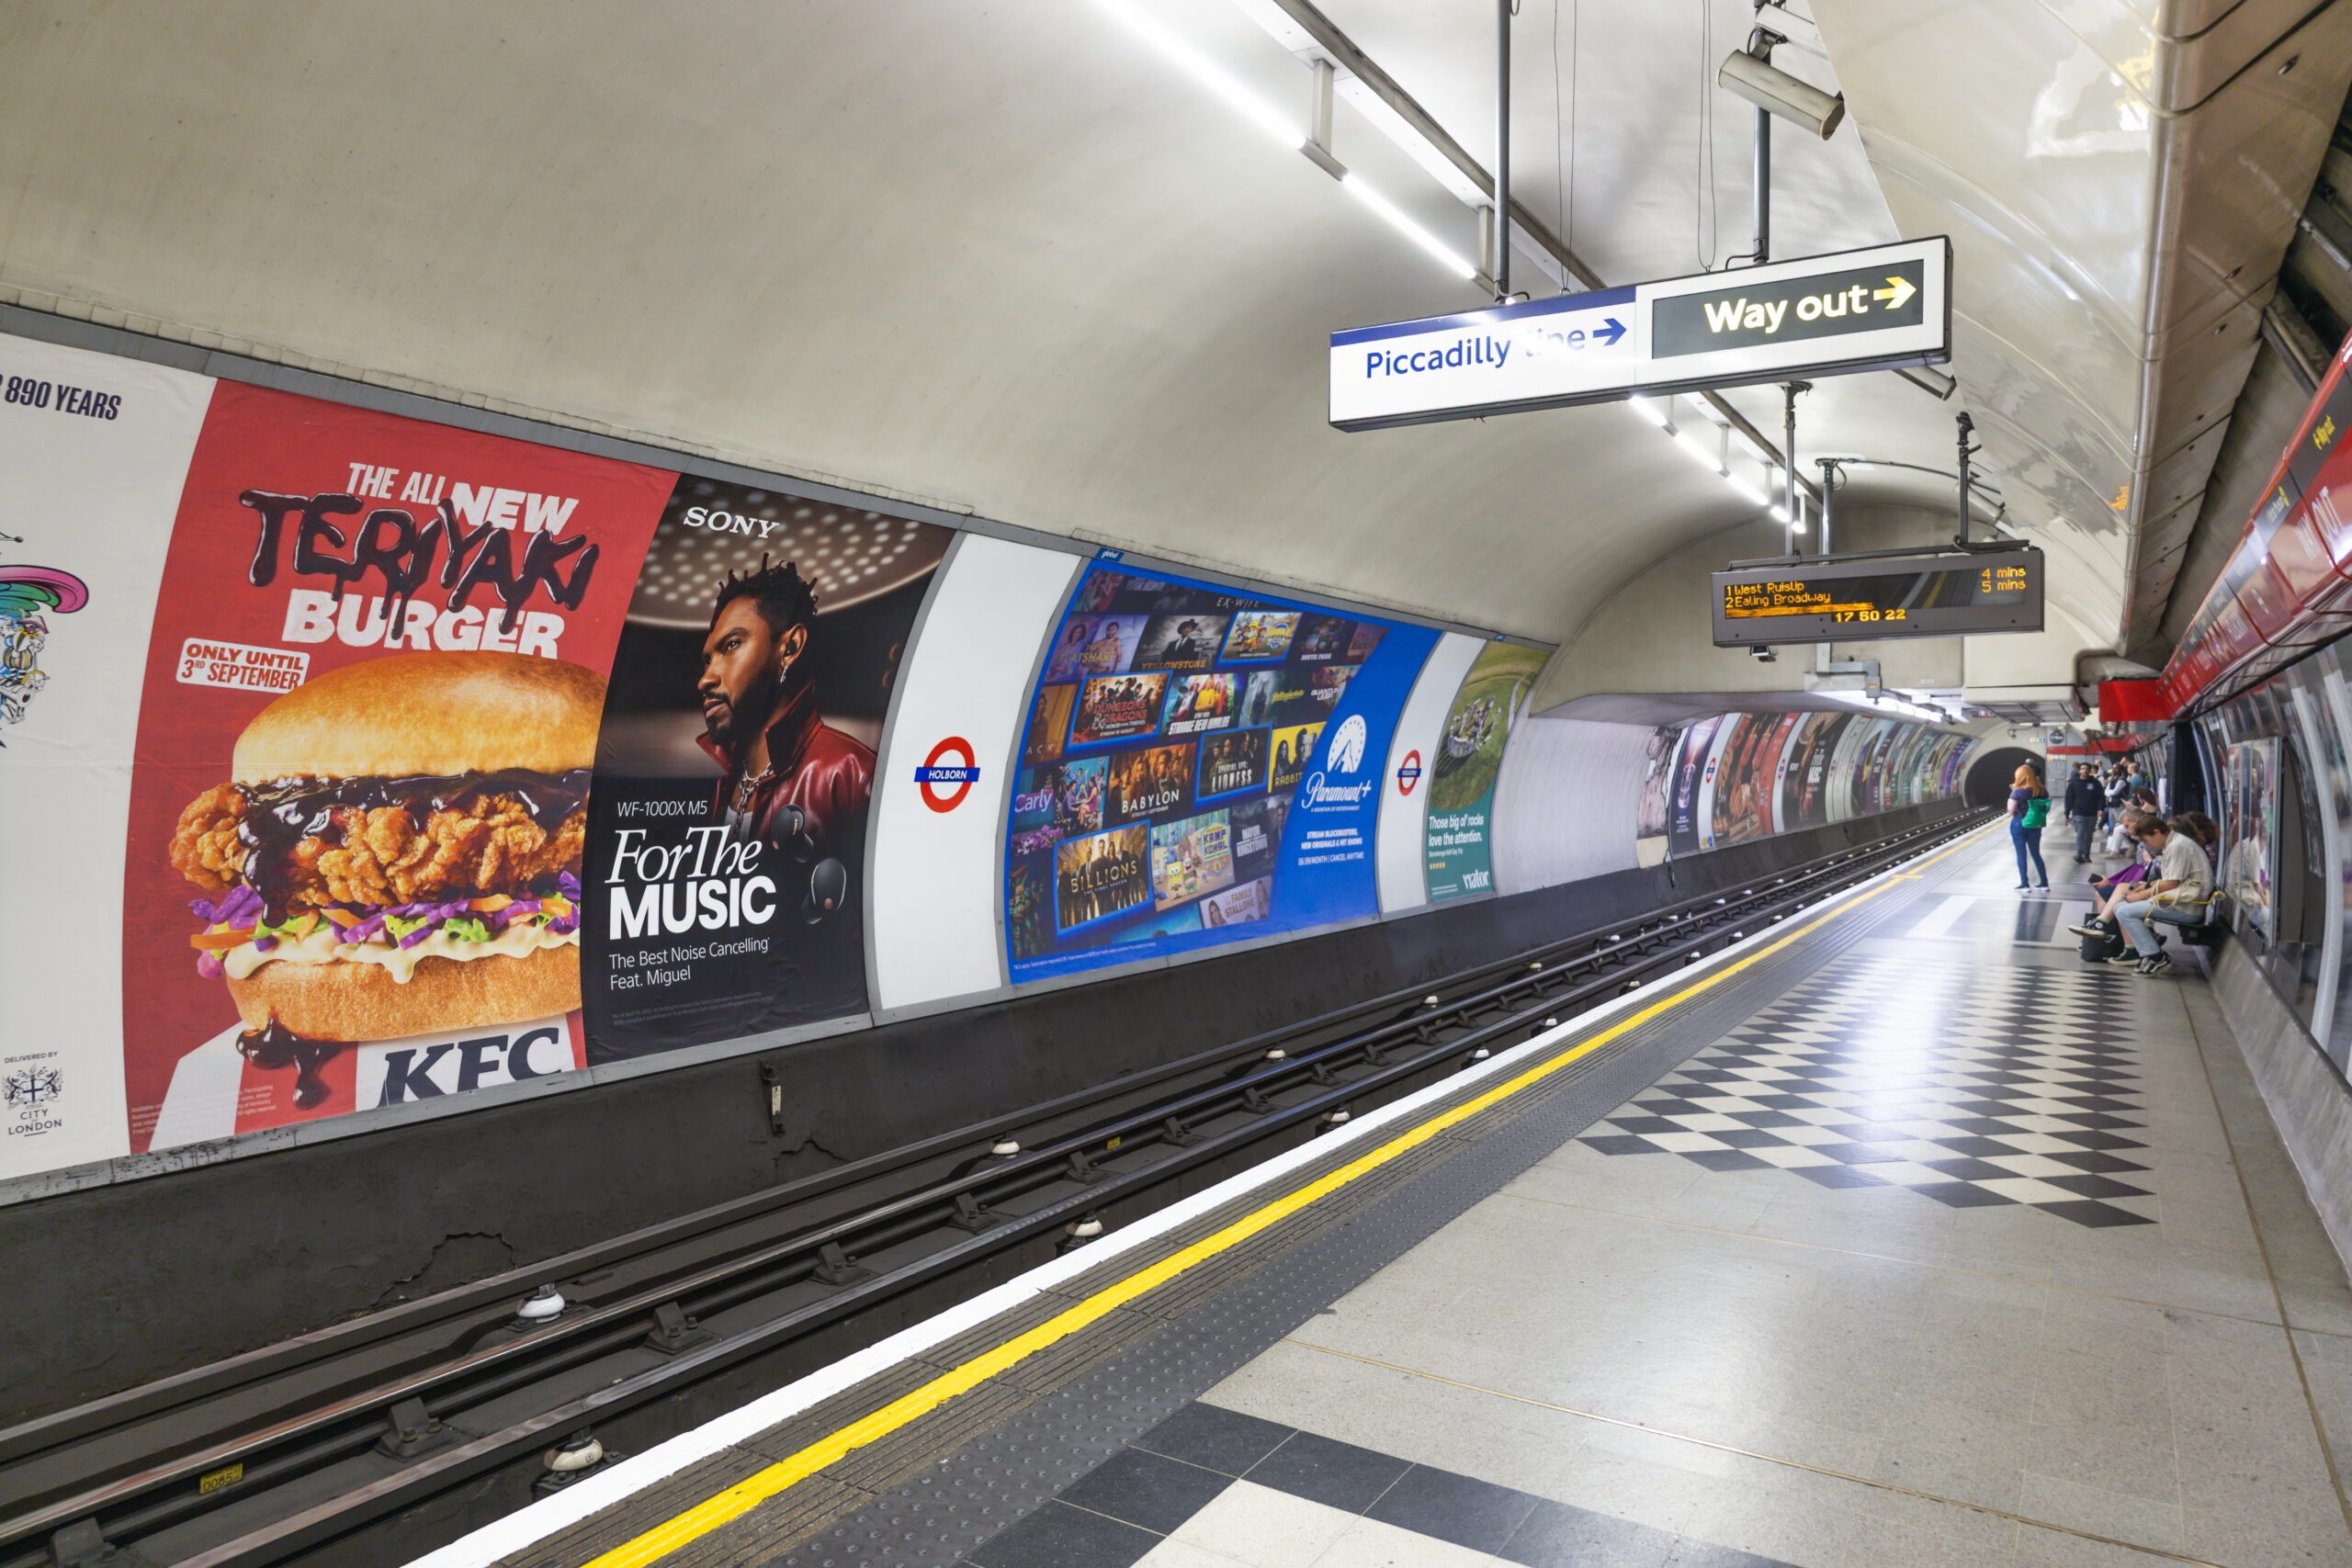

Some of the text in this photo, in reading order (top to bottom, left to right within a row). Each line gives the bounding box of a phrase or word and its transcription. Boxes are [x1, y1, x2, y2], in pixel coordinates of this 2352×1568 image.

[1704, 285, 1869, 334] Way out
[1367, 328, 1586, 378] Piccadilly ne
[5, 376, 52, 409] 890
[55, 384, 122, 421] YEARS
[346, 462, 580, 536] THE ALL NEW
[683, 506, 780, 540] SONY
[239, 489, 600, 625] TERIYAKI
[1725, 579, 2026, 608] 2 Ealing Broadway 5 mins
[1726, 566, 2026, 597] 1 West Ruislip 4 mins
[281, 588, 565, 660] BURGER
[1836, 612, 1854, 624] 17
[1884, 609, 1906, 620] 22
[187, 644, 304, 671] ONLY UNTIL
[1141, 660, 1207, 671] YELLOWSTONE
[208, 662, 301, 690] SEPTEMBER
[928, 770, 967, 780] HOLBORN
[1122, 788, 1181, 814] BABYLON
[1301, 771, 1372, 808] Paramount+
[617, 800, 708, 817] WF-1000X M5
[1429, 815, 1449, 830] Those
[1449, 814, 1460, 831] big
[1468, 813, 1484, 827] rocks
[1429, 829, 1483, 847] love the attention.
[1070, 860, 1137, 894] BILLIONS
[609, 874, 777, 941] MUSIC
[609, 952, 635, 970] The
[639, 949, 668, 966] Best
[671, 944, 707, 962] Noise
[610, 964, 691, 991] Feat. Miguel
[5, 1053, 46, 1064] DELIVERED
[377, 1027, 561, 1108] KFC
[8, 1119, 62, 1135] LONDON
[20, 1108, 48, 1121] CITY
